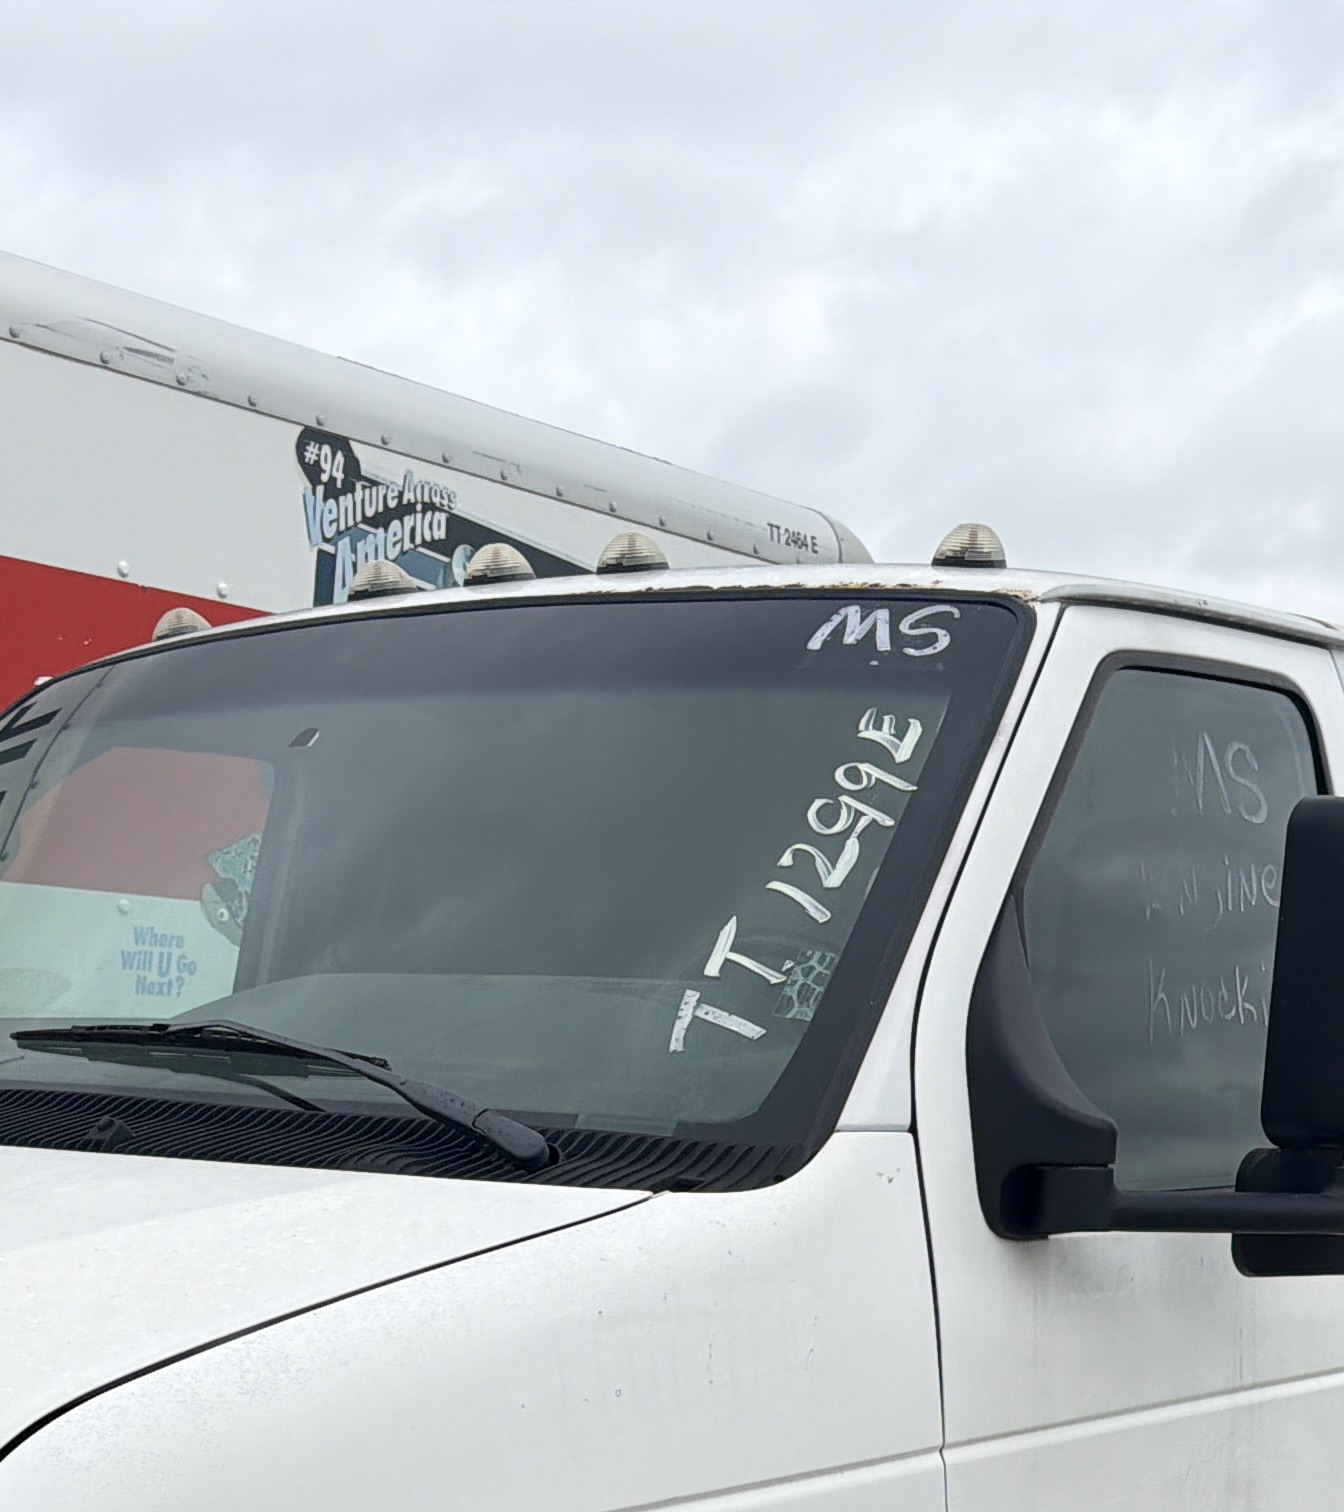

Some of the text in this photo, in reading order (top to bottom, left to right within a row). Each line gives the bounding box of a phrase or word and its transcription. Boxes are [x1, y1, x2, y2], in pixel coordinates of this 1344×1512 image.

[303, 440, 345, 489] #94
[302, 479, 400, 547] Venture
[766, 522, 781, 544] TT
[810, 535, 819, 555] E
[805, 604, 961, 657] MS
[133, 925, 185, 949] Where
[121, 949, 198, 979] Will U Go
